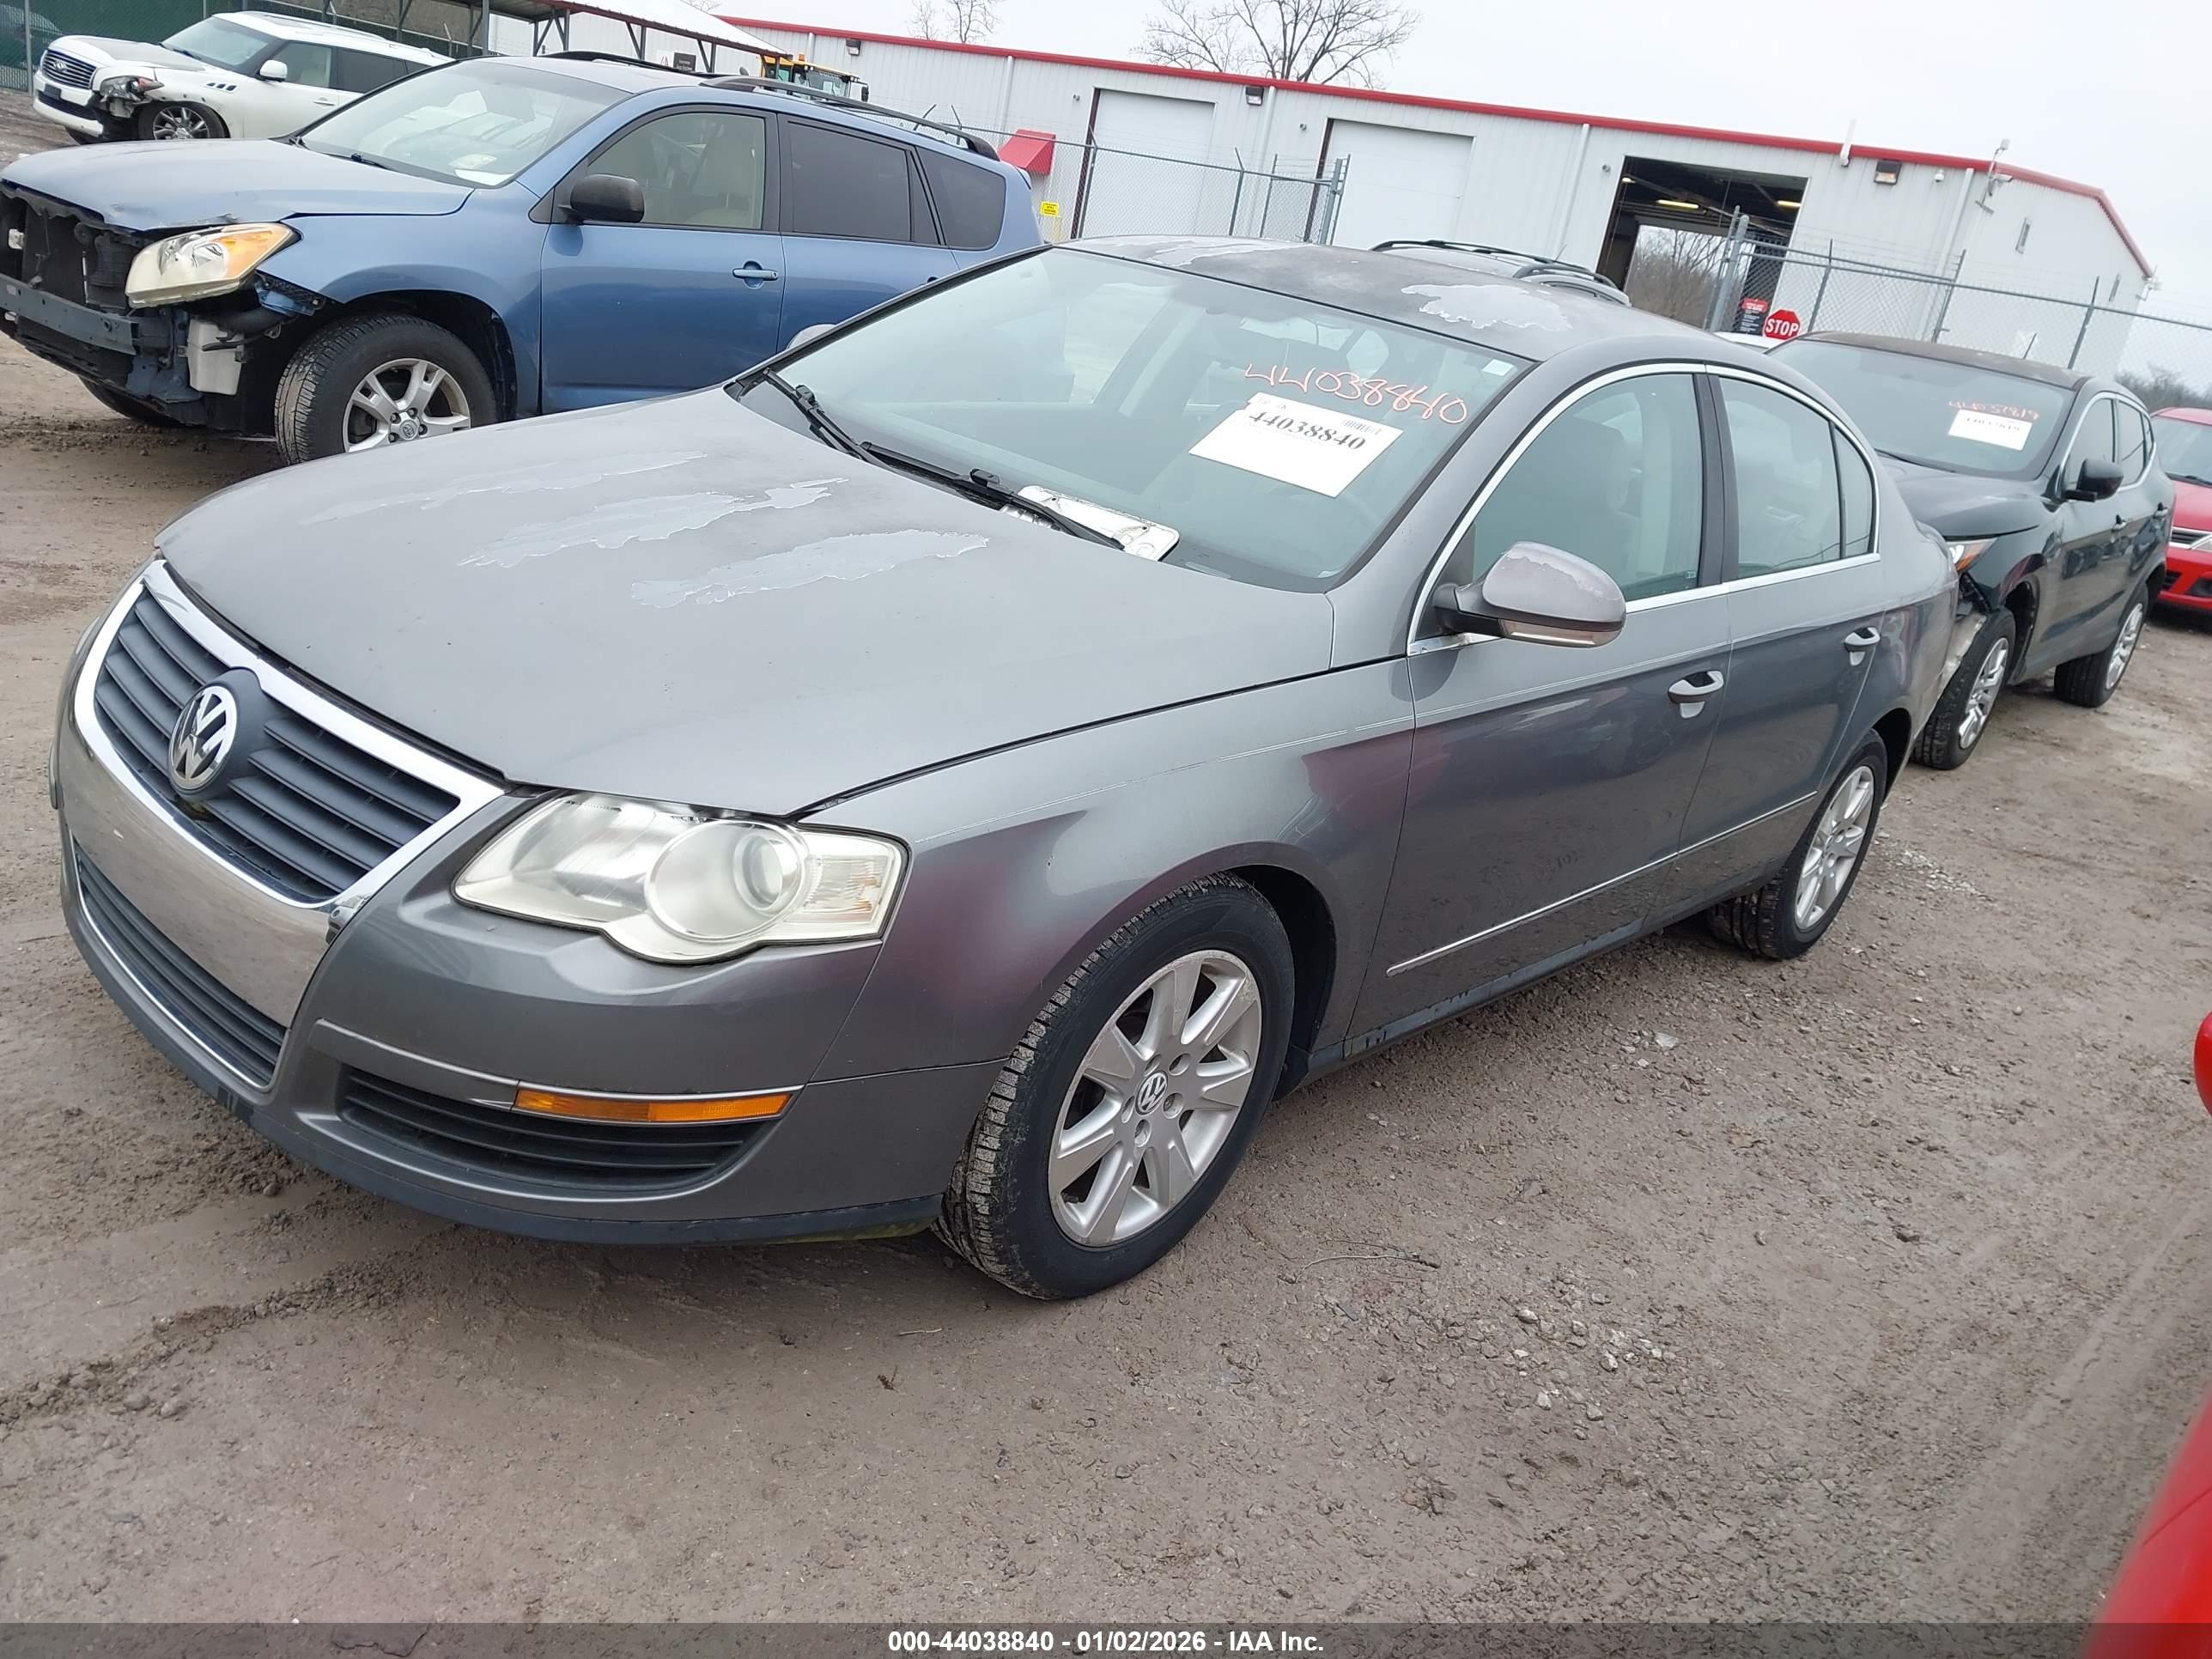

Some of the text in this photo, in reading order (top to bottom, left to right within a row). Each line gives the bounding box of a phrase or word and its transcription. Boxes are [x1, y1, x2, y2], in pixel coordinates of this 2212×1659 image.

[1765, 318, 1799, 337] STOP
[1244, 363, 1468, 424] 44038840
[1249, 411, 1367, 450] 44038840
